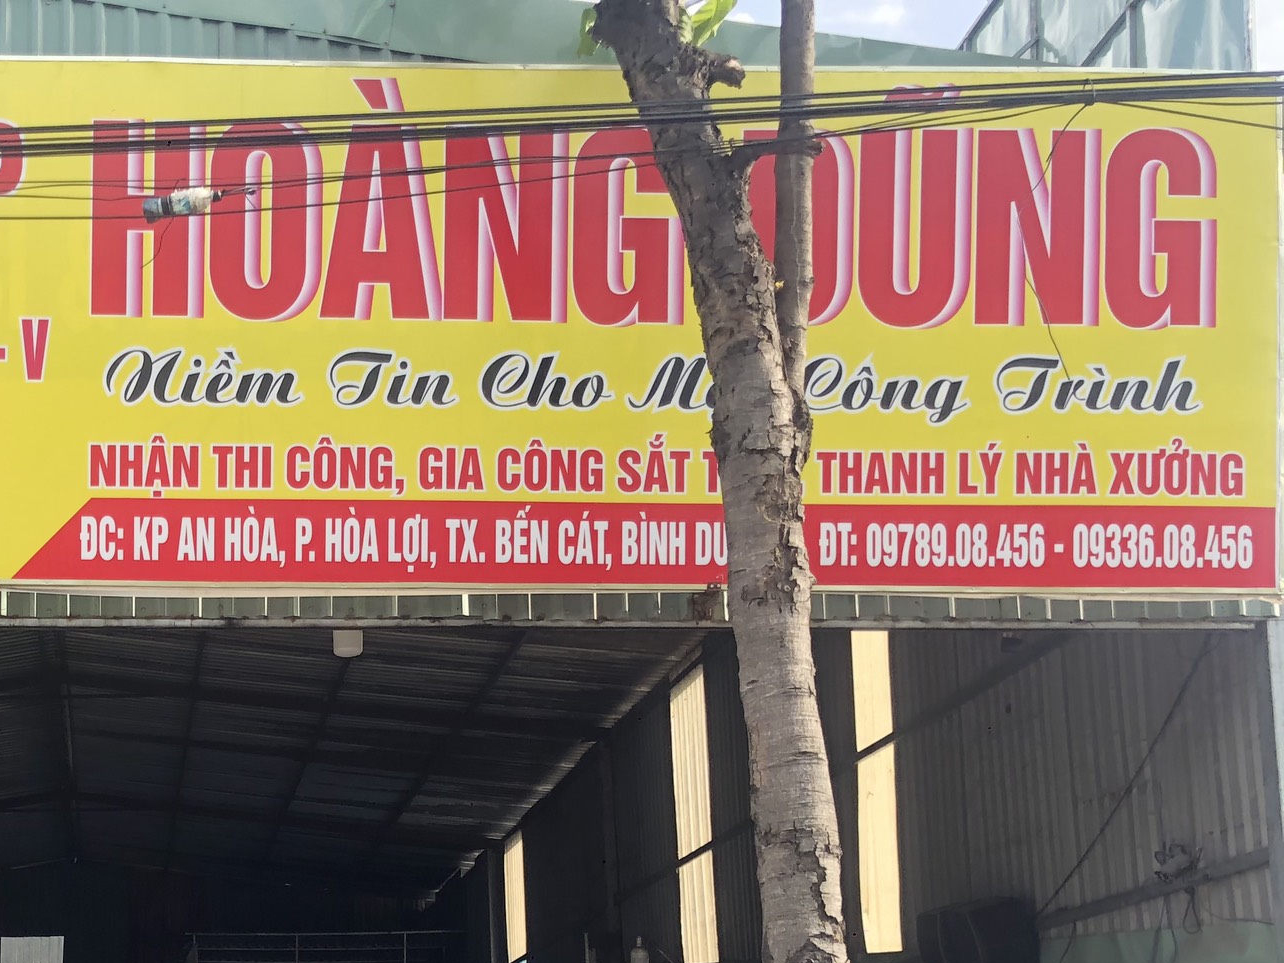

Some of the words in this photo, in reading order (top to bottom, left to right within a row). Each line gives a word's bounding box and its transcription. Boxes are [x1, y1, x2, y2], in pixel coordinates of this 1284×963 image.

[92, 80, 684, 324] HOÀNG
[22, 320, 48, 379] V
[106, 350, 300, 404] Niềm
[330, 351, 453, 405] Tin
[481, 353, 609, 408] Cho
[803, 357, 966, 424] Công
[997, 356, 1198, 411] Trình
[91, 436, 199, 498] NHẬN
[213, 446, 271, 488] THI
[287, 438, 404, 494] CÔNG,
[420, 448, 483, 489] GIA
[498, 440, 602, 491] CÔNG
[618, 435, 690, 492] SẮT
[818, 452, 944, 493] THANH
[960, 444, 1001, 494] LÝ
[1017, 444, 1096, 493] NHÀ
[1111, 440, 1242, 495] XƯỞNG
[80, 516, 123, 560] ĐC:
[134, 517, 168, 560] KP
[178, 517, 214, 561] AN
[225, 506, 285, 567] HÒA,
[296, 518, 315, 561] P.
[326, 507, 378, 562] HÒA
[388, 514, 436, 572] LỢI,
[446, 519, 485, 562] TX.
[496, 506, 548, 563] BẾN
[559, 511, 611, 570] CÁT,
[622, 512, 685, 565] BÌNH
[819, 523, 856, 565] ĐT:
[867, 523, 1044, 567] 09789.08.456
[1073, 524, 1252, 568] 09336.08.456
